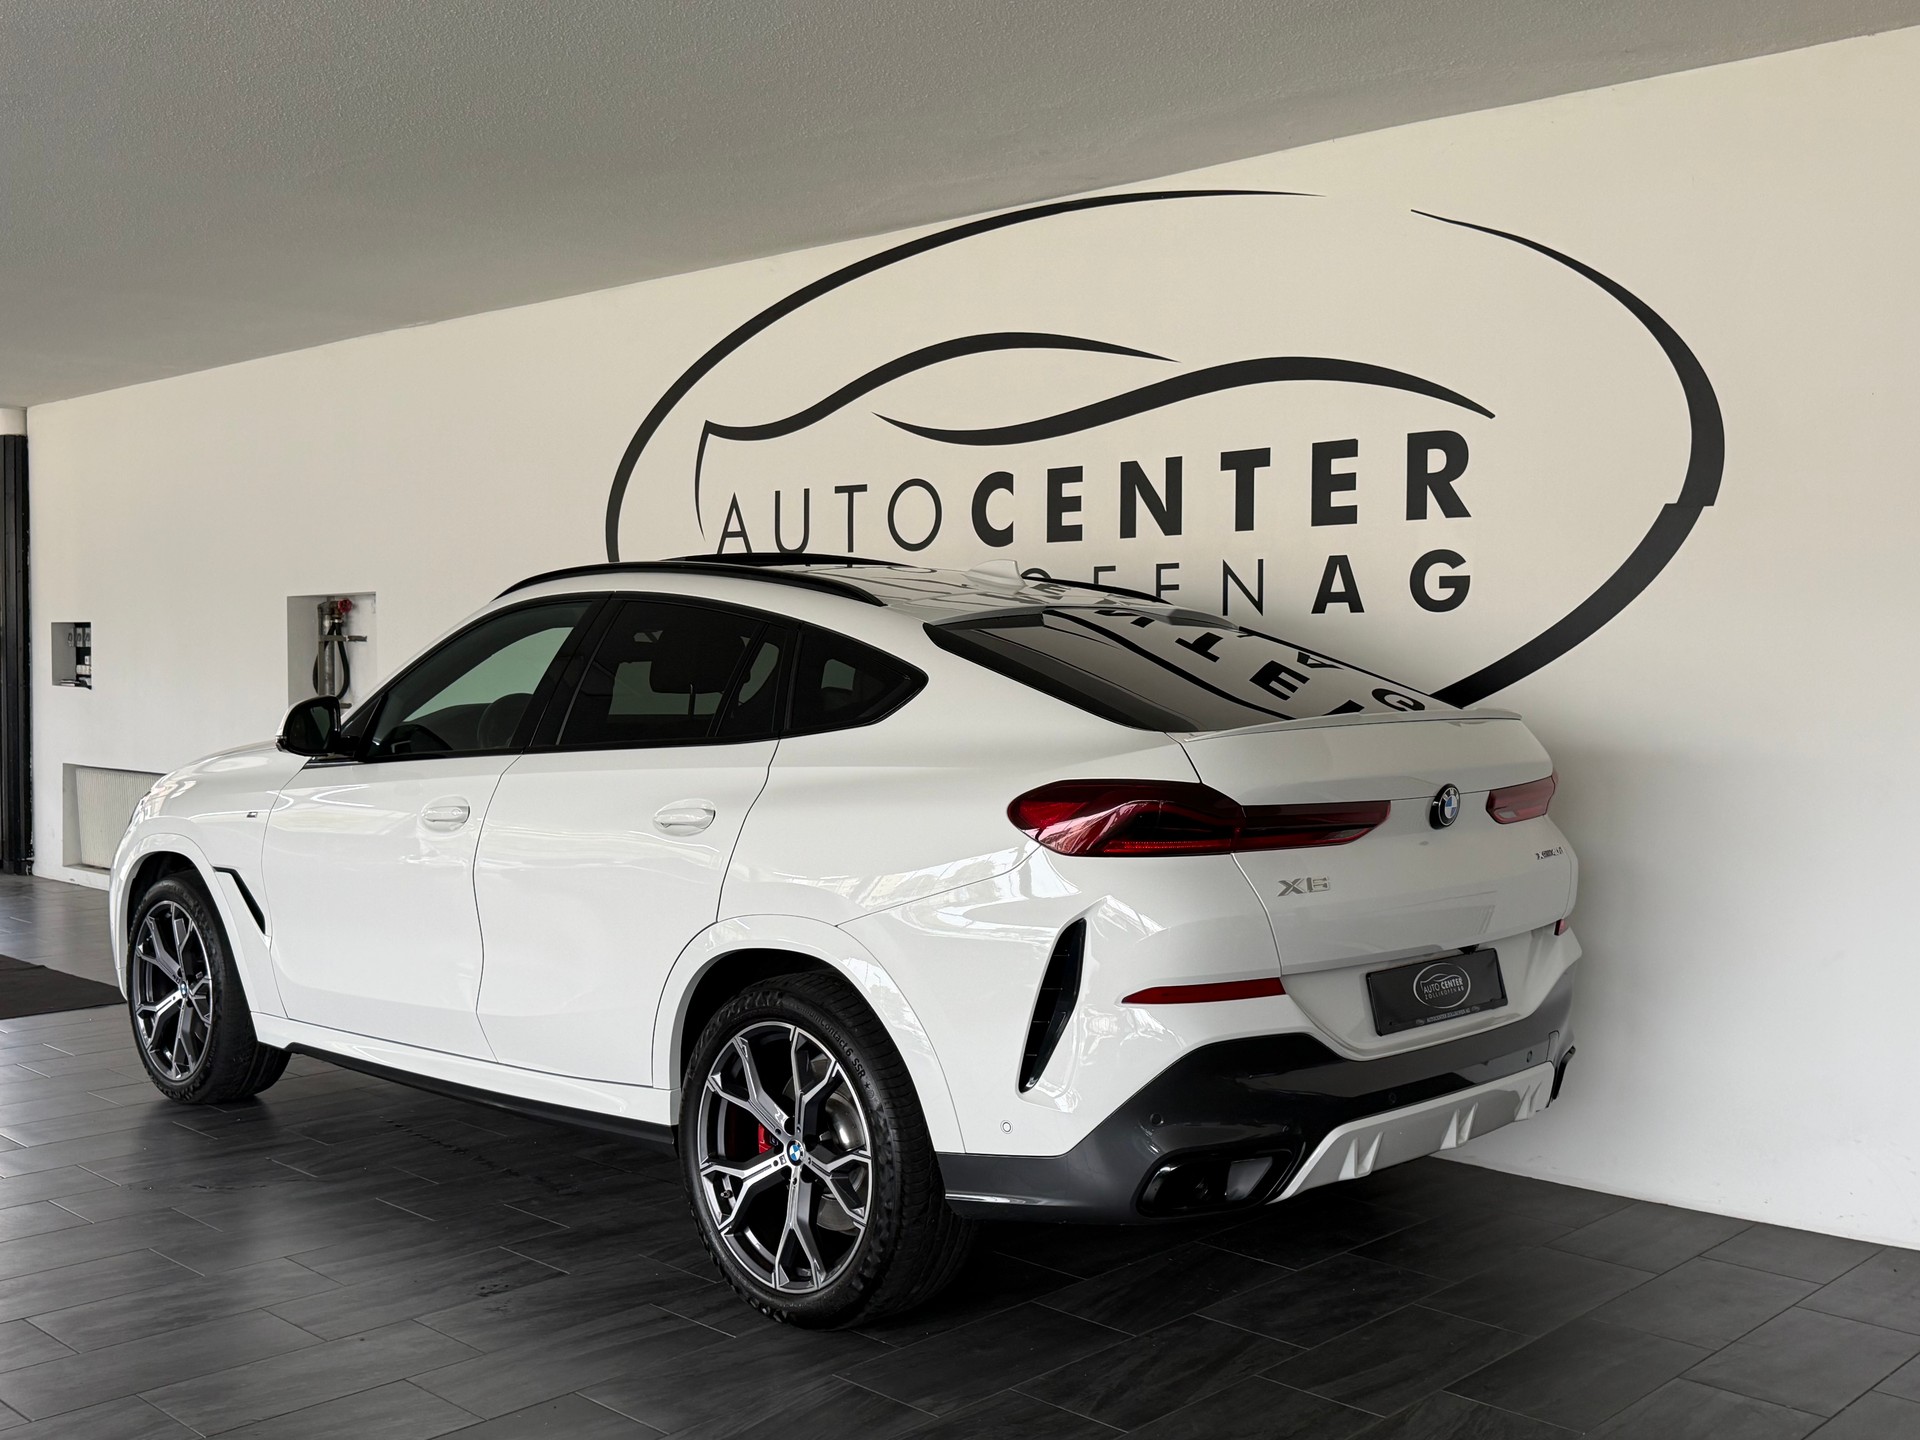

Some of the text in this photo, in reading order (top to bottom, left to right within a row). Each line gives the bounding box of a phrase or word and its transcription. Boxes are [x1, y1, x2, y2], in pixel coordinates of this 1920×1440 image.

[1277, 876, 1330, 897] X6
[1440, 977, 1464, 990] CENTER
[851, 1057, 866, 1078] SSR
